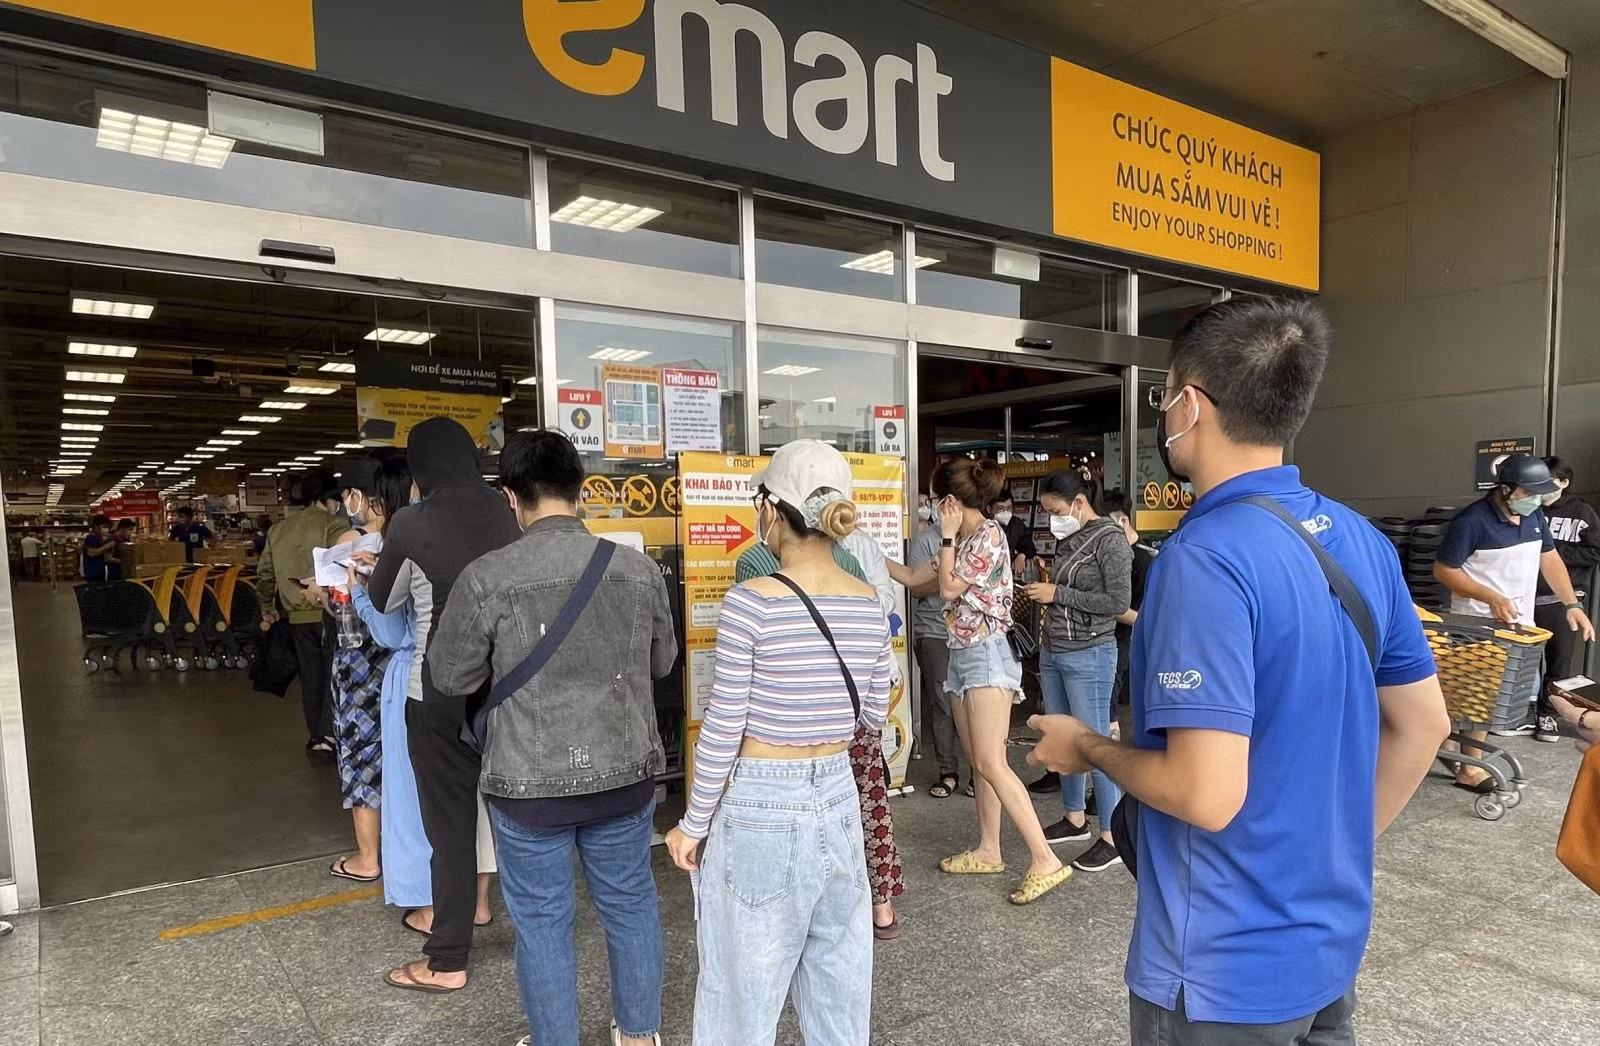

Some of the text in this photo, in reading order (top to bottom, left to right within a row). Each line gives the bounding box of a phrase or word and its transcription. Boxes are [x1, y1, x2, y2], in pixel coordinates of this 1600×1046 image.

[1112, 112, 1282, 188] CHÚC QUÝ KHÁCH
[1116, 161, 1165, 199] MUA
[1171, 169, 1211, 212] SẮM
[1215, 189, 1247, 221] VUI
[1251, 196, 1271, 227] VẺ
[1112, 201, 1160, 231] ENJOY
[1164, 214, 1205, 242] YOUR
[1208, 226, 1276, 259] SHOPPING
[411, 363, 497, 379] NƠI ĐỂ XE MUA HÀNG
[666, 372, 696, 385] THÔNG
[698, 374, 716, 387] BÁO
[569, 392, 584, 401] LƯU
[581, 434, 599, 446] VÀO
[622, 444, 646, 454] emart
[880, 442, 900, 452] LỐI RA
[726, 456, 755, 468] emart
[685, 478, 709, 490] KHAI
[712, 477, 732, 490] BÁO
[735, 480, 742, 491] Y
[1158, 672, 1182, 684] TECS
